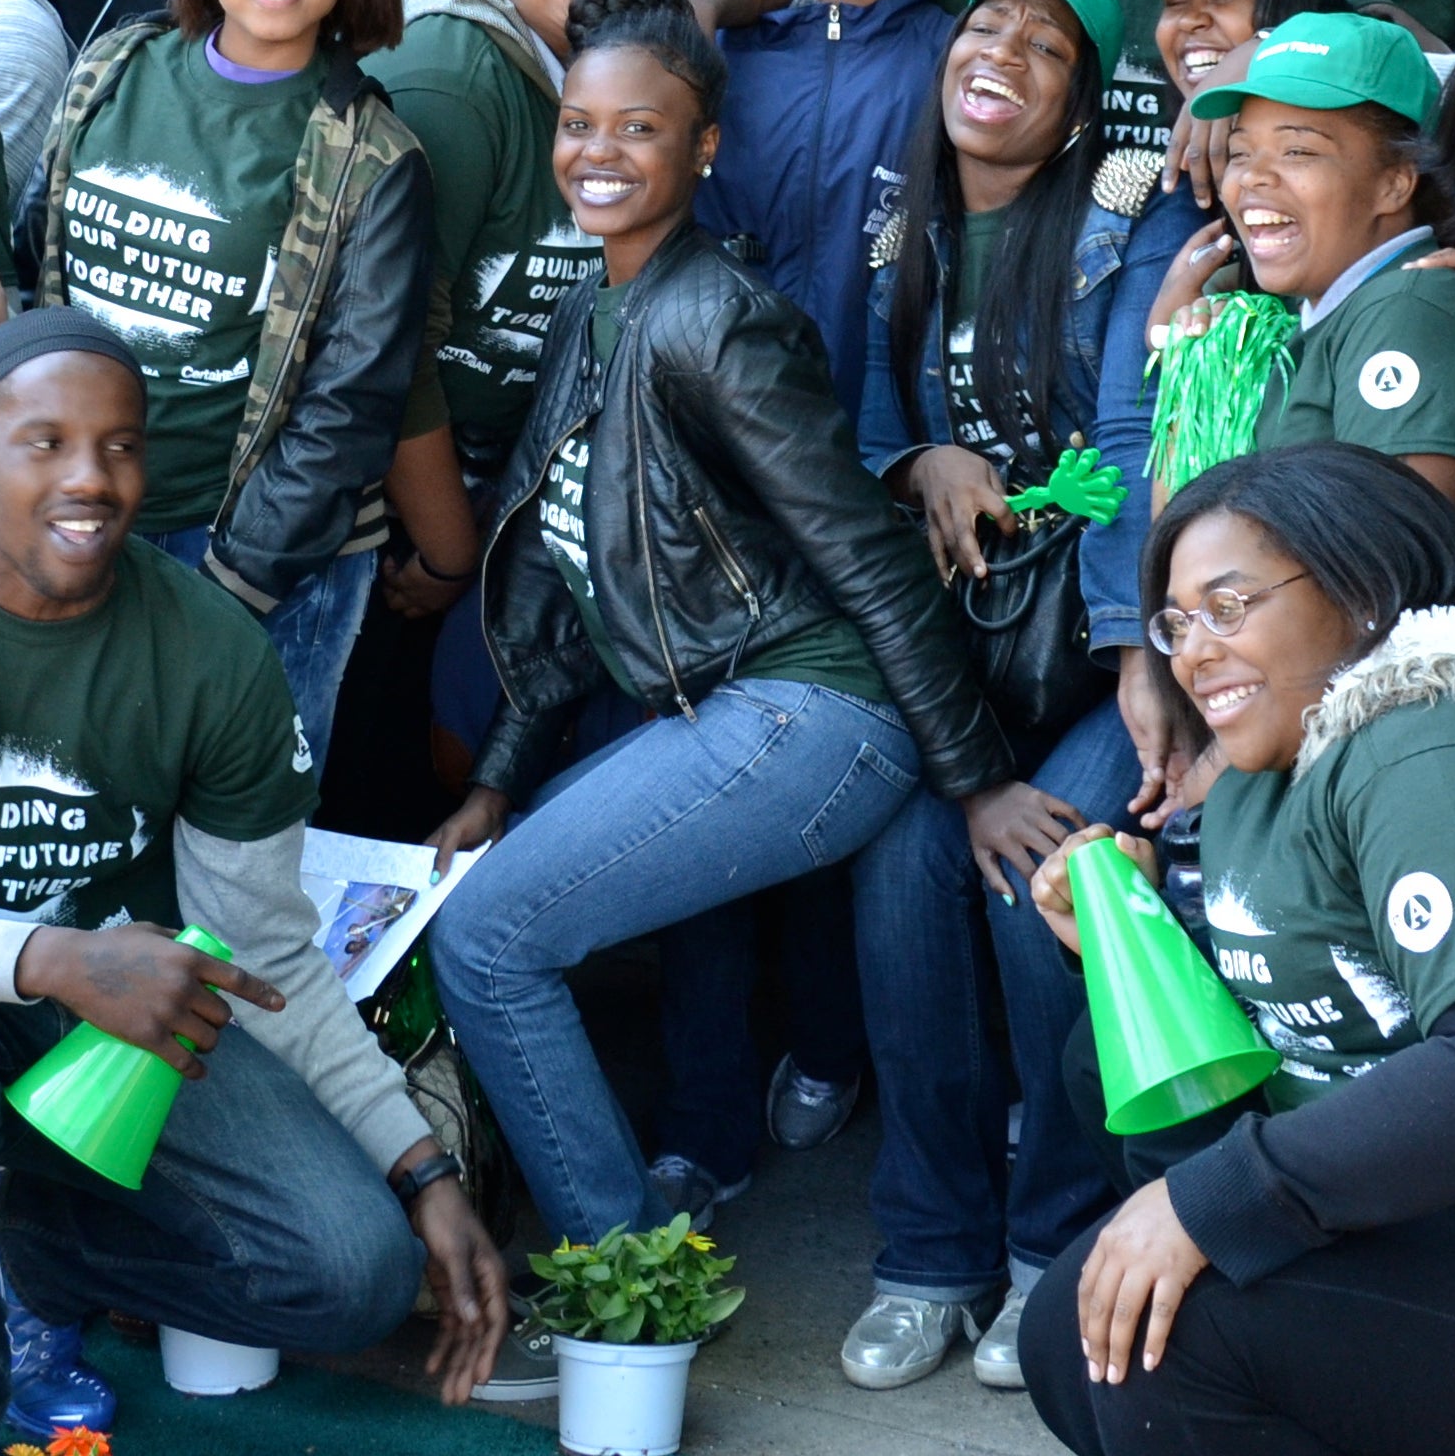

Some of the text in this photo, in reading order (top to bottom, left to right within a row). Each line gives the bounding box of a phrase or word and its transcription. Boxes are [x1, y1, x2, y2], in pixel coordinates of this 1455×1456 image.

[65, 188, 211, 254] BUILDING
[66, 251, 214, 322] TOGETHER
[69, 220, 247, 297] OUR FUTURE
[526, 256, 603, 281] BUILDIN
[1218, 948, 1274, 985] DING
